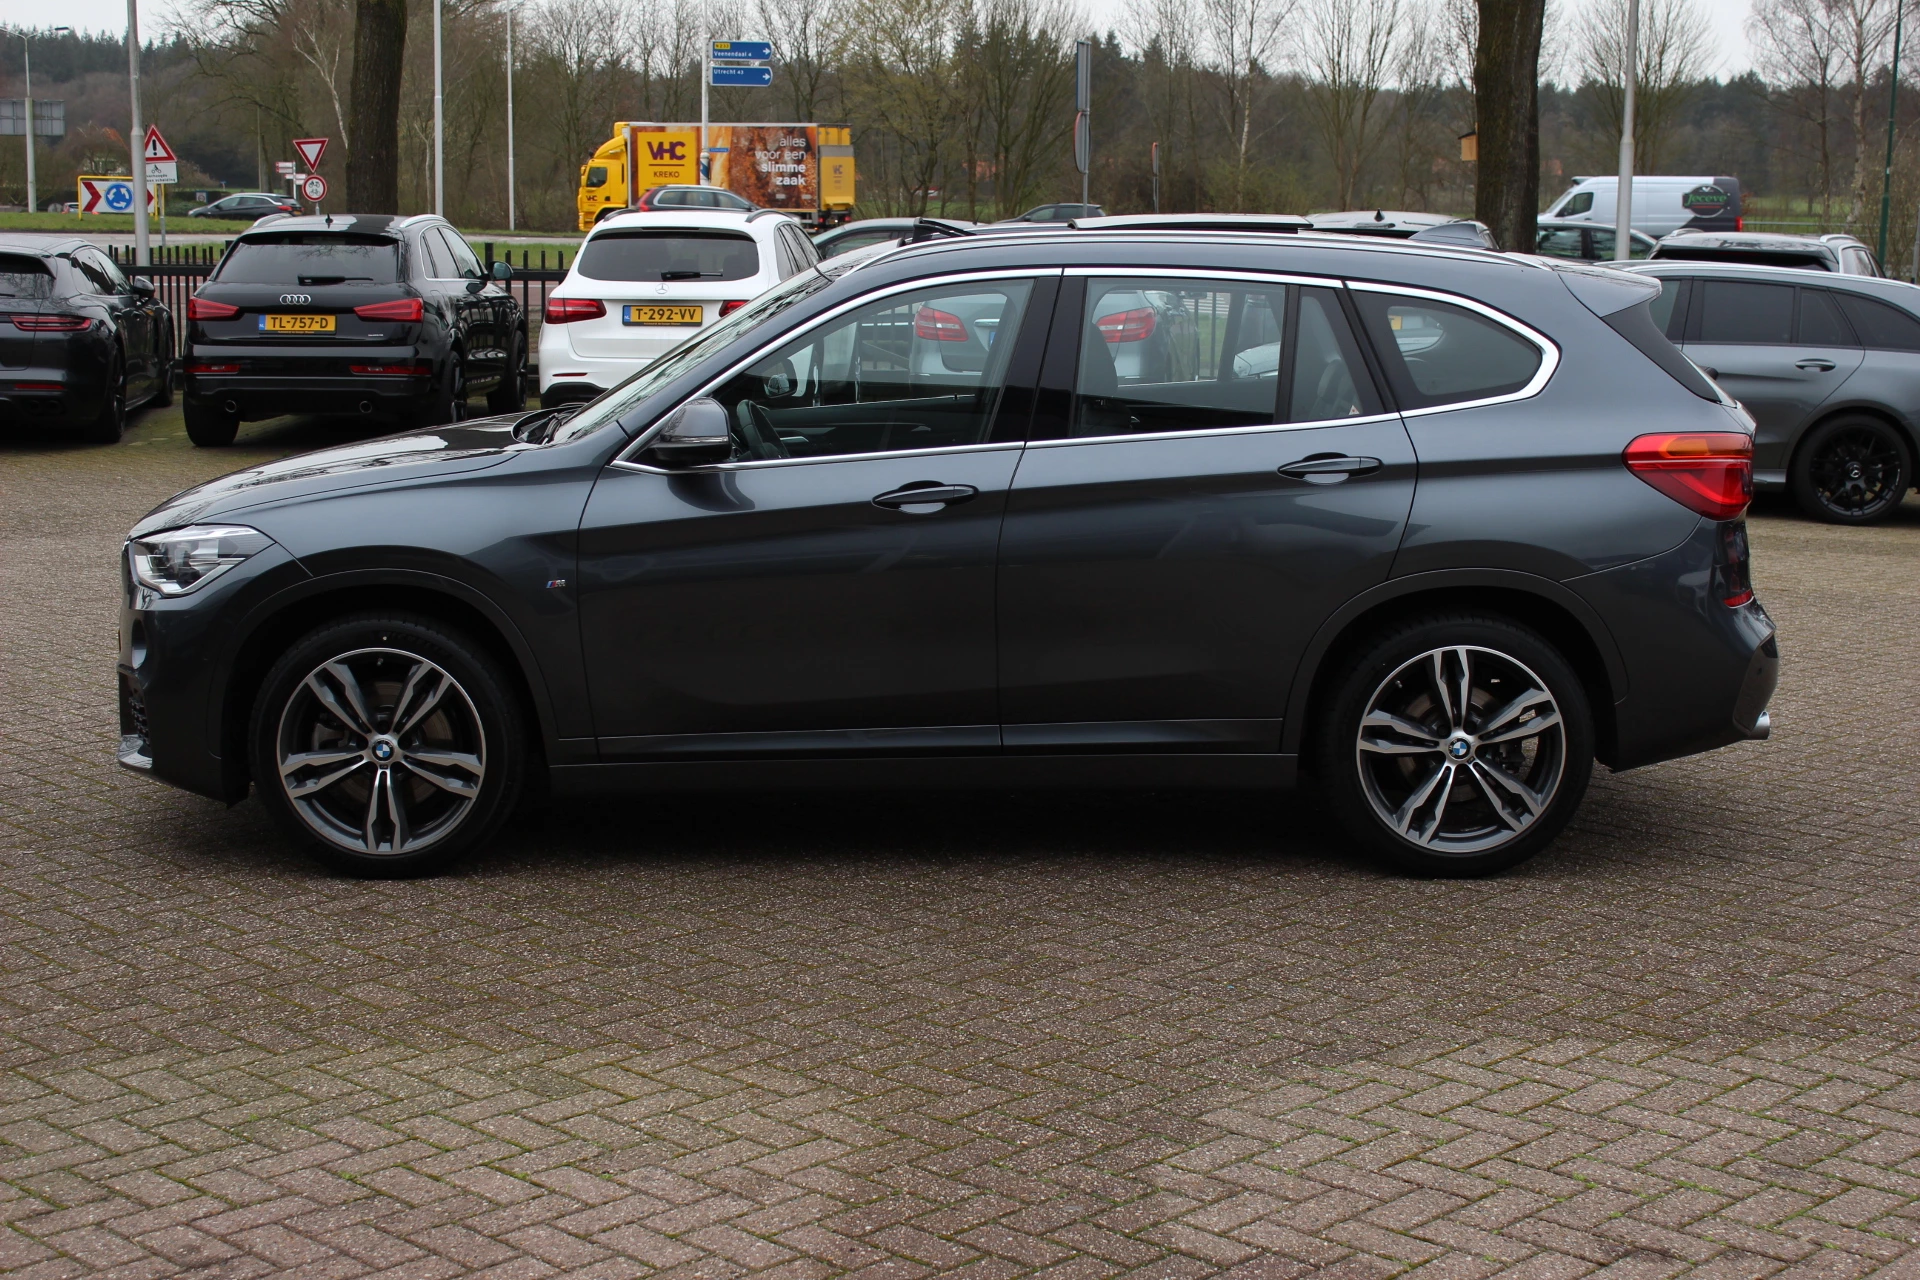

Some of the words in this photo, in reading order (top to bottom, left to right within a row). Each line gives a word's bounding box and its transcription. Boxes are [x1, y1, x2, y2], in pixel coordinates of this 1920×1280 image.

[780, 136, 806, 147] alles
[647, 141, 687, 161] VHC
[755, 151, 781, 160] voor
[784, 151, 806, 160] een
[761, 161, 806, 173] slimme
[776, 175, 806, 186] zaak
[636, 308, 696, 320] T-292-VV
[270, 316, 329, 329] TL-757-D
